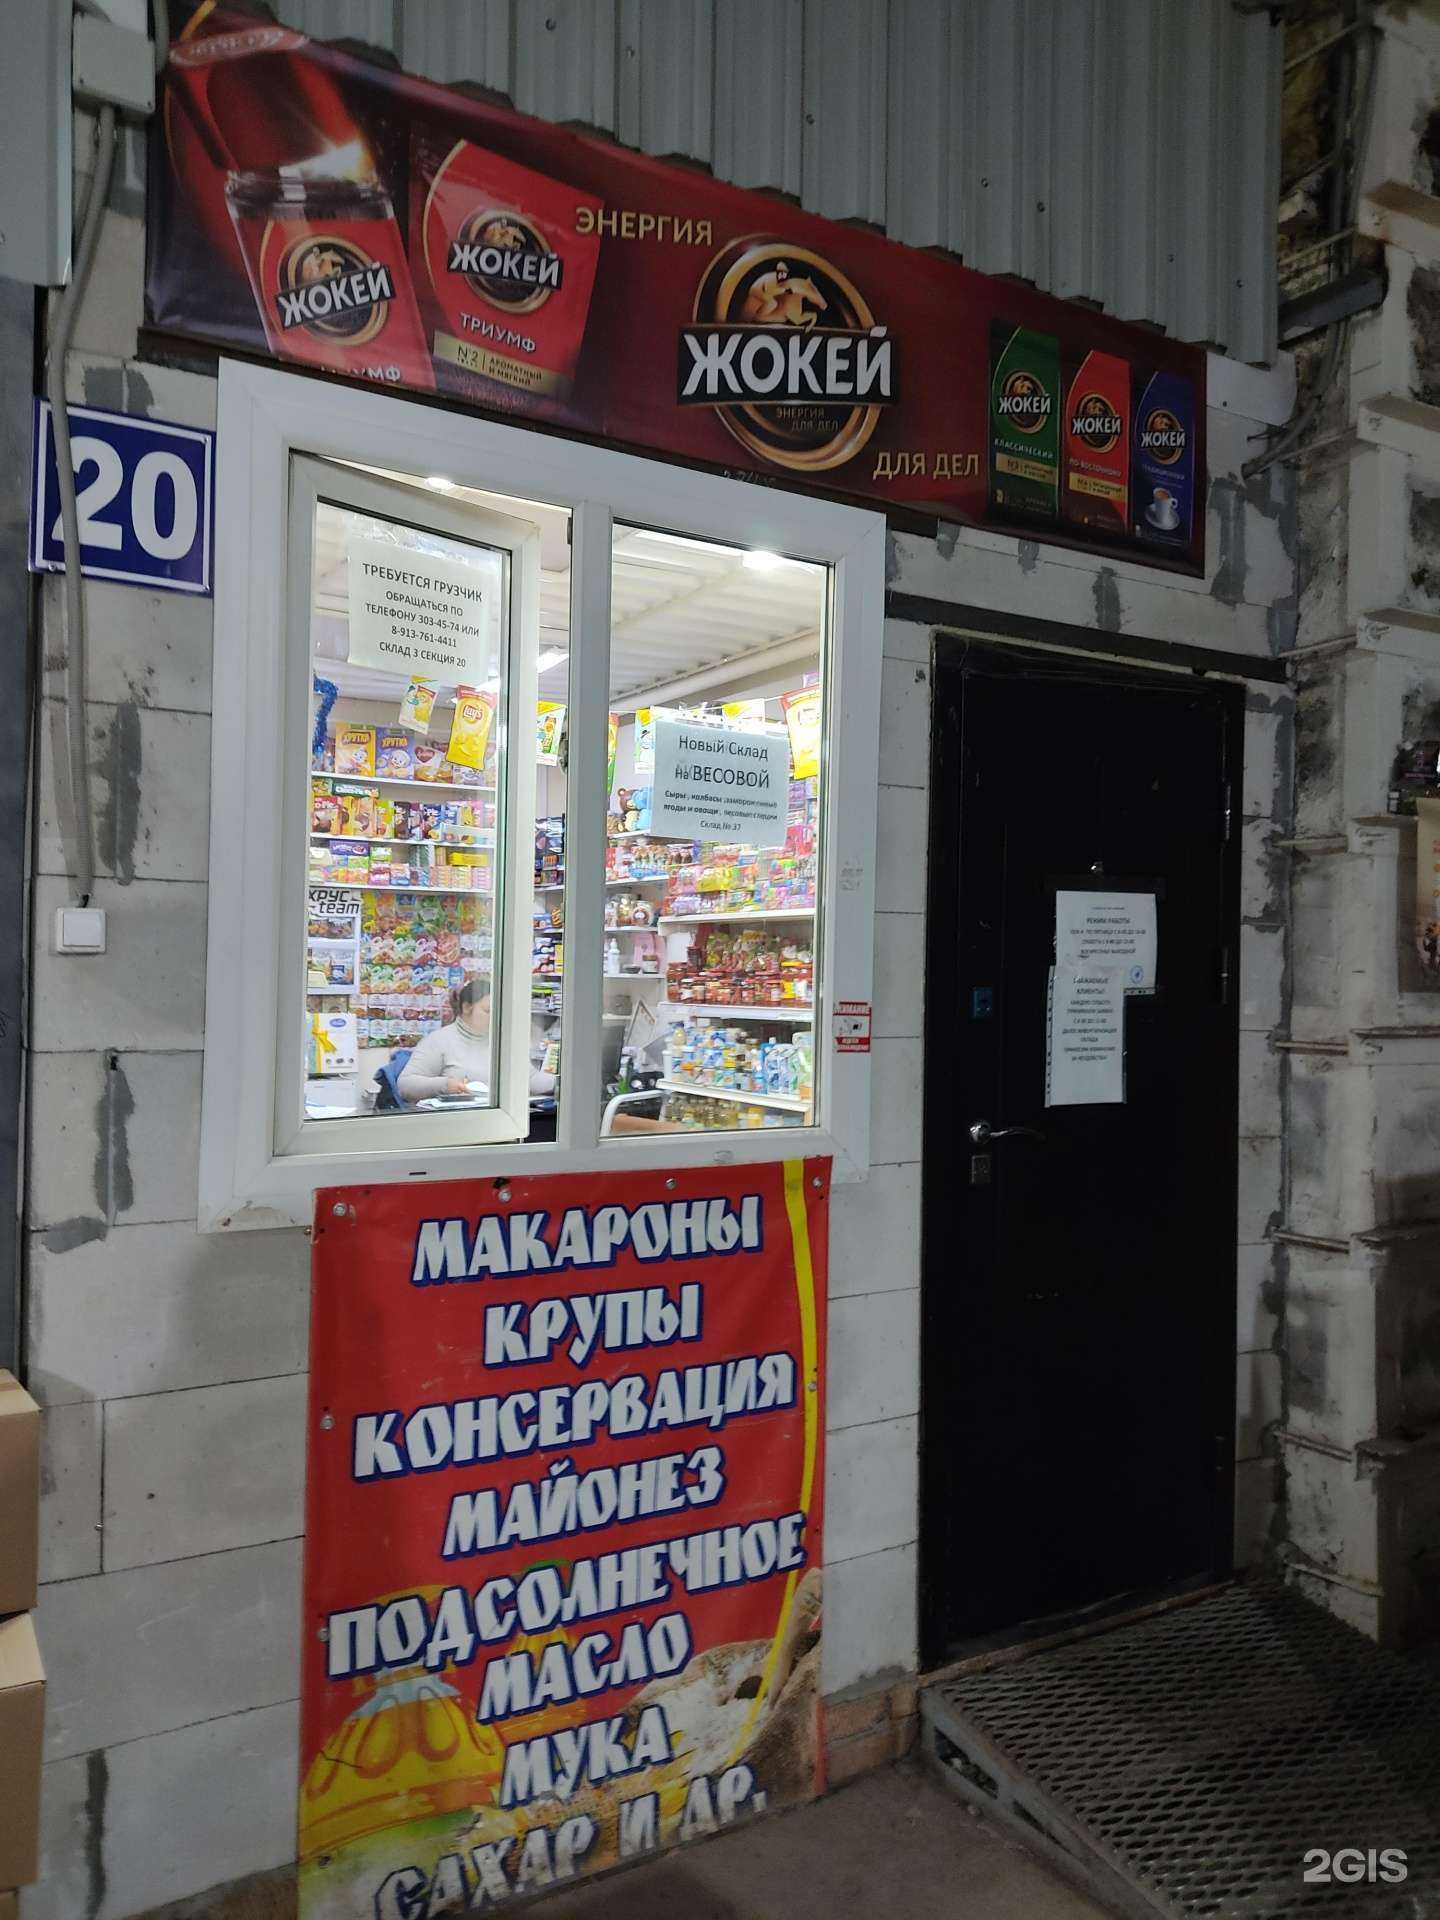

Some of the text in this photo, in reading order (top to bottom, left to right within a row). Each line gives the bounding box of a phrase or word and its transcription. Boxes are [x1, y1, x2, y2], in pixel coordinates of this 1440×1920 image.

[575, 208, 713, 246] ЭНЕРГИЯ
[450, 241, 560, 287] ЖОКЕЙ
[278, 267, 391, 327] ЖОКЕЙ
[460, 312, 536, 352] ТРИУМФ
[681, 326, 892, 397] ЖОКЕЙ
[776, 406, 825, 418] ЭНЕРГИЯ
[998, 393, 1051, 414] ЖОКЕЙ
[1072, 415, 1121, 435] ЖОКЕЙ
[1141, 429, 1186, 447] ЖОКЕЙ
[873, 452, 926, 481] ДЛЯ
[932, 453, 980, 481] ДЕЛ
[51, 435, 198, 561] 20
[362, 562, 482, 602] ТРЕБУЕТСЯ ГРУЗЧИК
[366, 603, 480, 637] ТЕЛЕФОНУ 303-45-74 ИЛИ
[385, 590, 463, 617] ОБРАЩАТЬСЯ ПО
[379, 641, 467, 668] СКЛАД 3 СЕКЦИЯ 20
[391, 625, 457, 648] 8-913-761-4411
[679, 735, 768, 760] Новый Склад
[692, 765, 770, 789] ВЕСОВОЙ
[319, 901, 359, 914] team
[411, 1194, 763, 1285] МАКАРОНЫ
[483, 1283, 701, 1368] КРУПЫ
[353, 1353, 796, 1479] КОНСЕРВАЦИЯ
[442, 1445, 725, 1557] МАЙОНЕЗ
[327, 1512, 806, 1678] ПОДСОЛНЕЧНОЕ
[478, 1612, 692, 1722] МАСЛО
[501, 1705, 674, 1807] МУКА
[375, 1814, 596, 1920] САХАР
[618, 1792, 660, 1858] И
